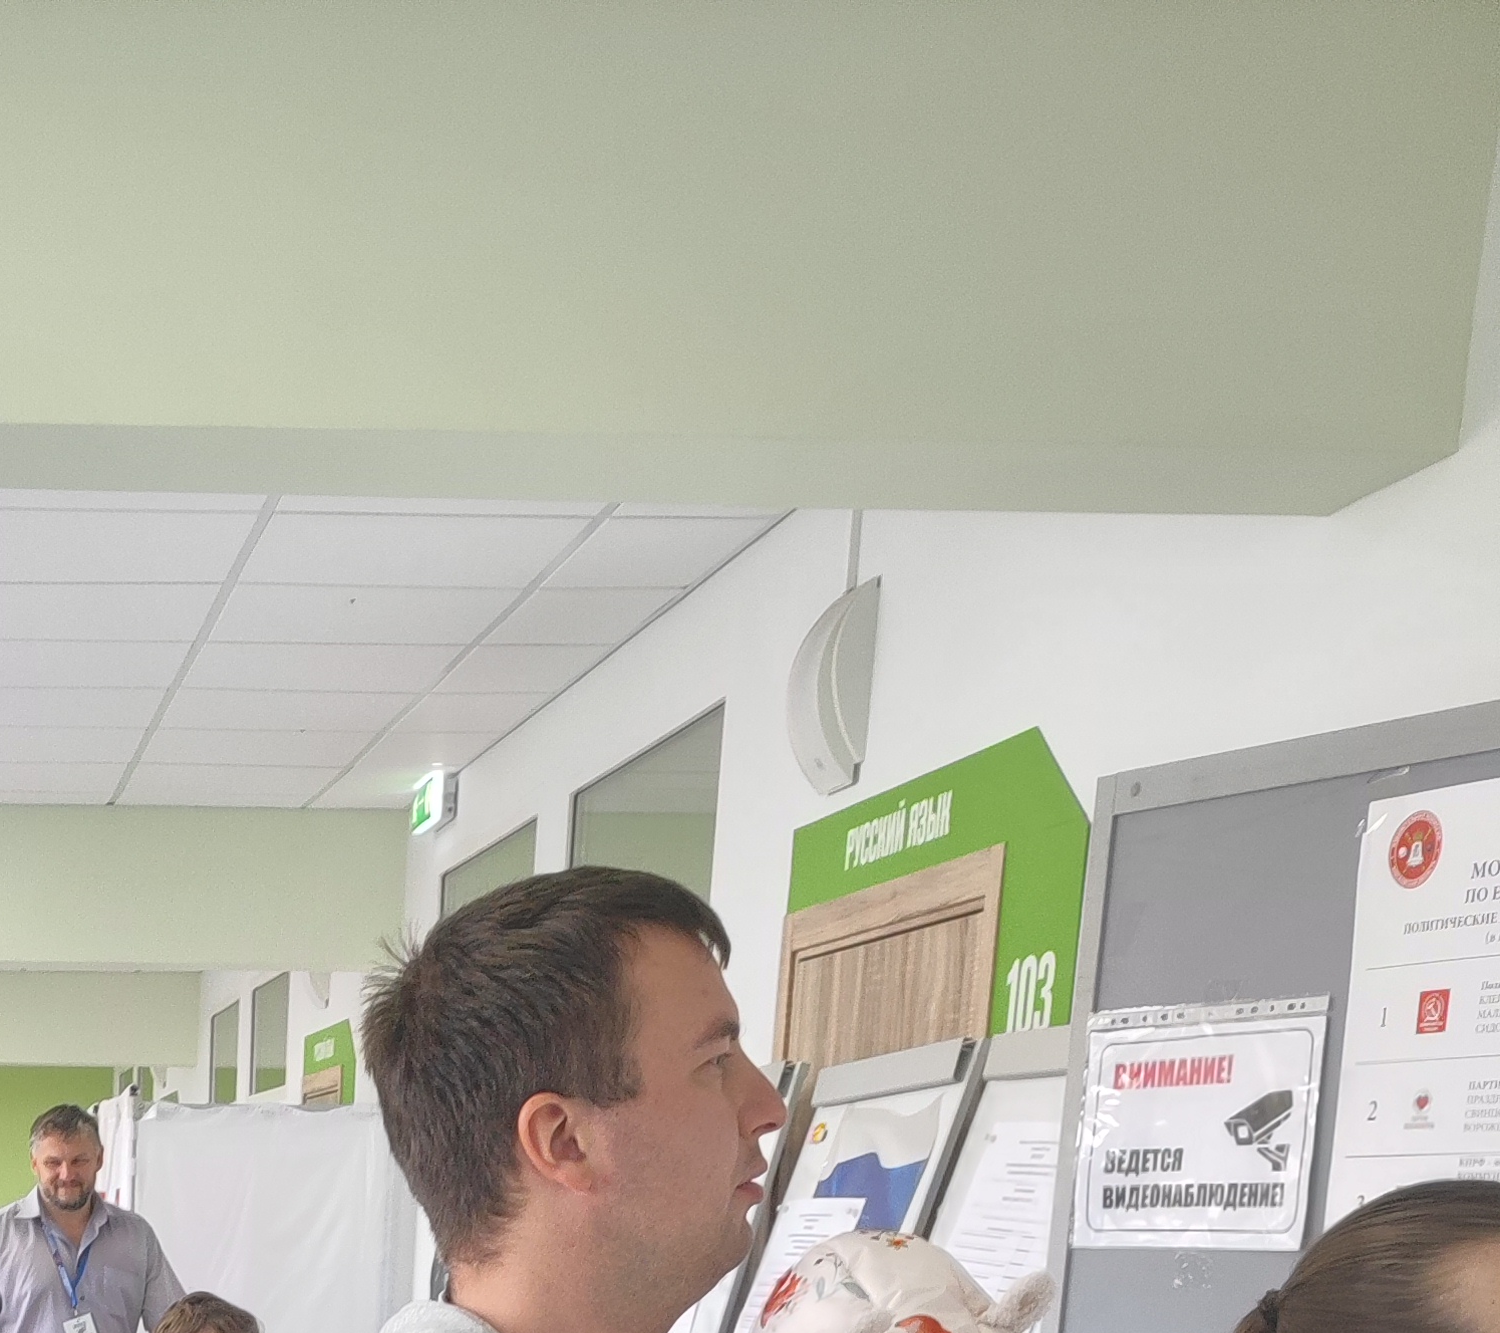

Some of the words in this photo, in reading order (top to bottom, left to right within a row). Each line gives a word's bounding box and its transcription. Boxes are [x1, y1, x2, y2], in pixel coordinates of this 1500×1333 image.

[844, 798, 906, 871] РУССКИЙ
[907, 789, 953, 848] ЯЗЫК
[1464, 886, 1488, 904] ПО
[1403, 911, 1498, 935] ПОЛИТИЧЕСКИЕ
[1006, 950, 1056, 1033] 103
[1380, 1007, 1387, 1028] 1
[1113, 1054, 1234, 1090] ВНИМАНИЕ!
[1367, 1100, 1378, 1121] 2
[1103, 1148, 1184, 1177] ВЕДЕТСЯ
[1103, 1182, 1285, 1212] ВИДЕОНАБЛЮДЕНИЕ!
